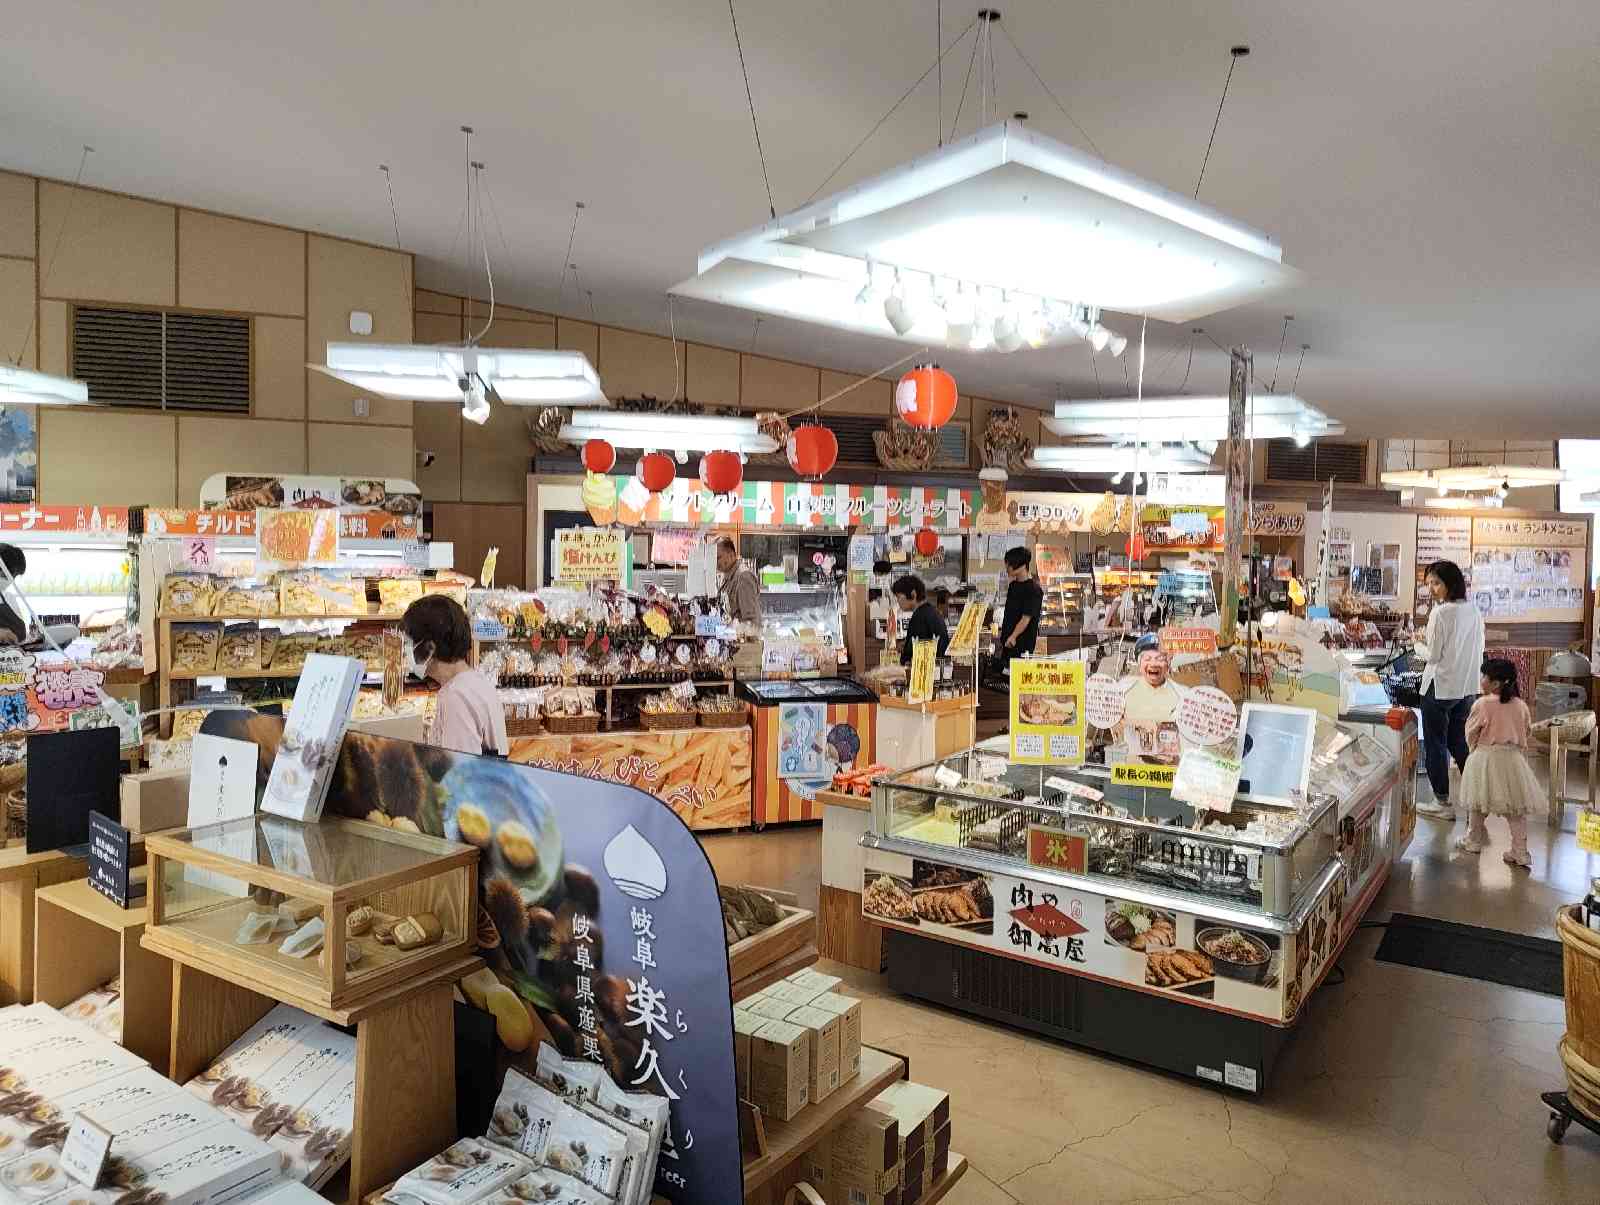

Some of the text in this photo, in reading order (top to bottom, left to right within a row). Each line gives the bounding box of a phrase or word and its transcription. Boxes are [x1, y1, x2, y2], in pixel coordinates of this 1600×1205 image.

[847, 496, 972, 520] フルーツジェラート
[1011, 882, 1059, 912] 肉や
[572, 912, 603, 1063] 岐阜県産栗
